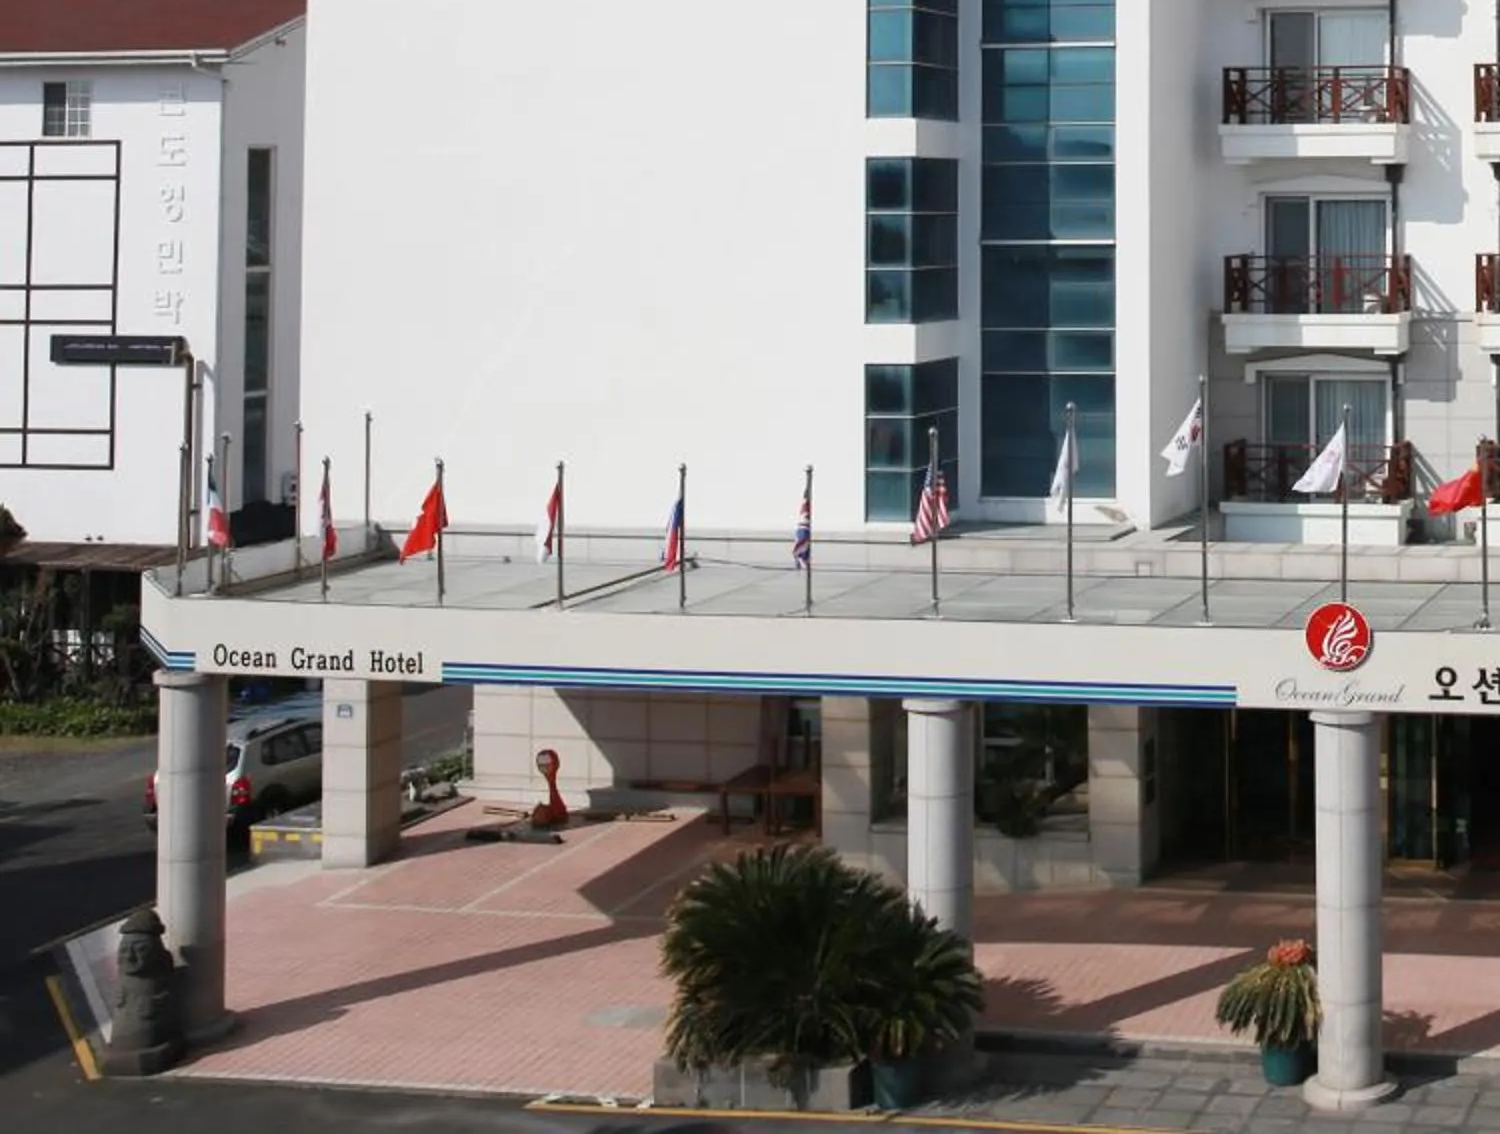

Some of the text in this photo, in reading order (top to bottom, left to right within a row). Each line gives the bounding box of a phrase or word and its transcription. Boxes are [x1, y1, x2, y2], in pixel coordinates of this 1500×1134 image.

[213, 643, 424, 674] Ocean Grand Hotel
[1275, 674, 1406, 707] Ocean Grand
